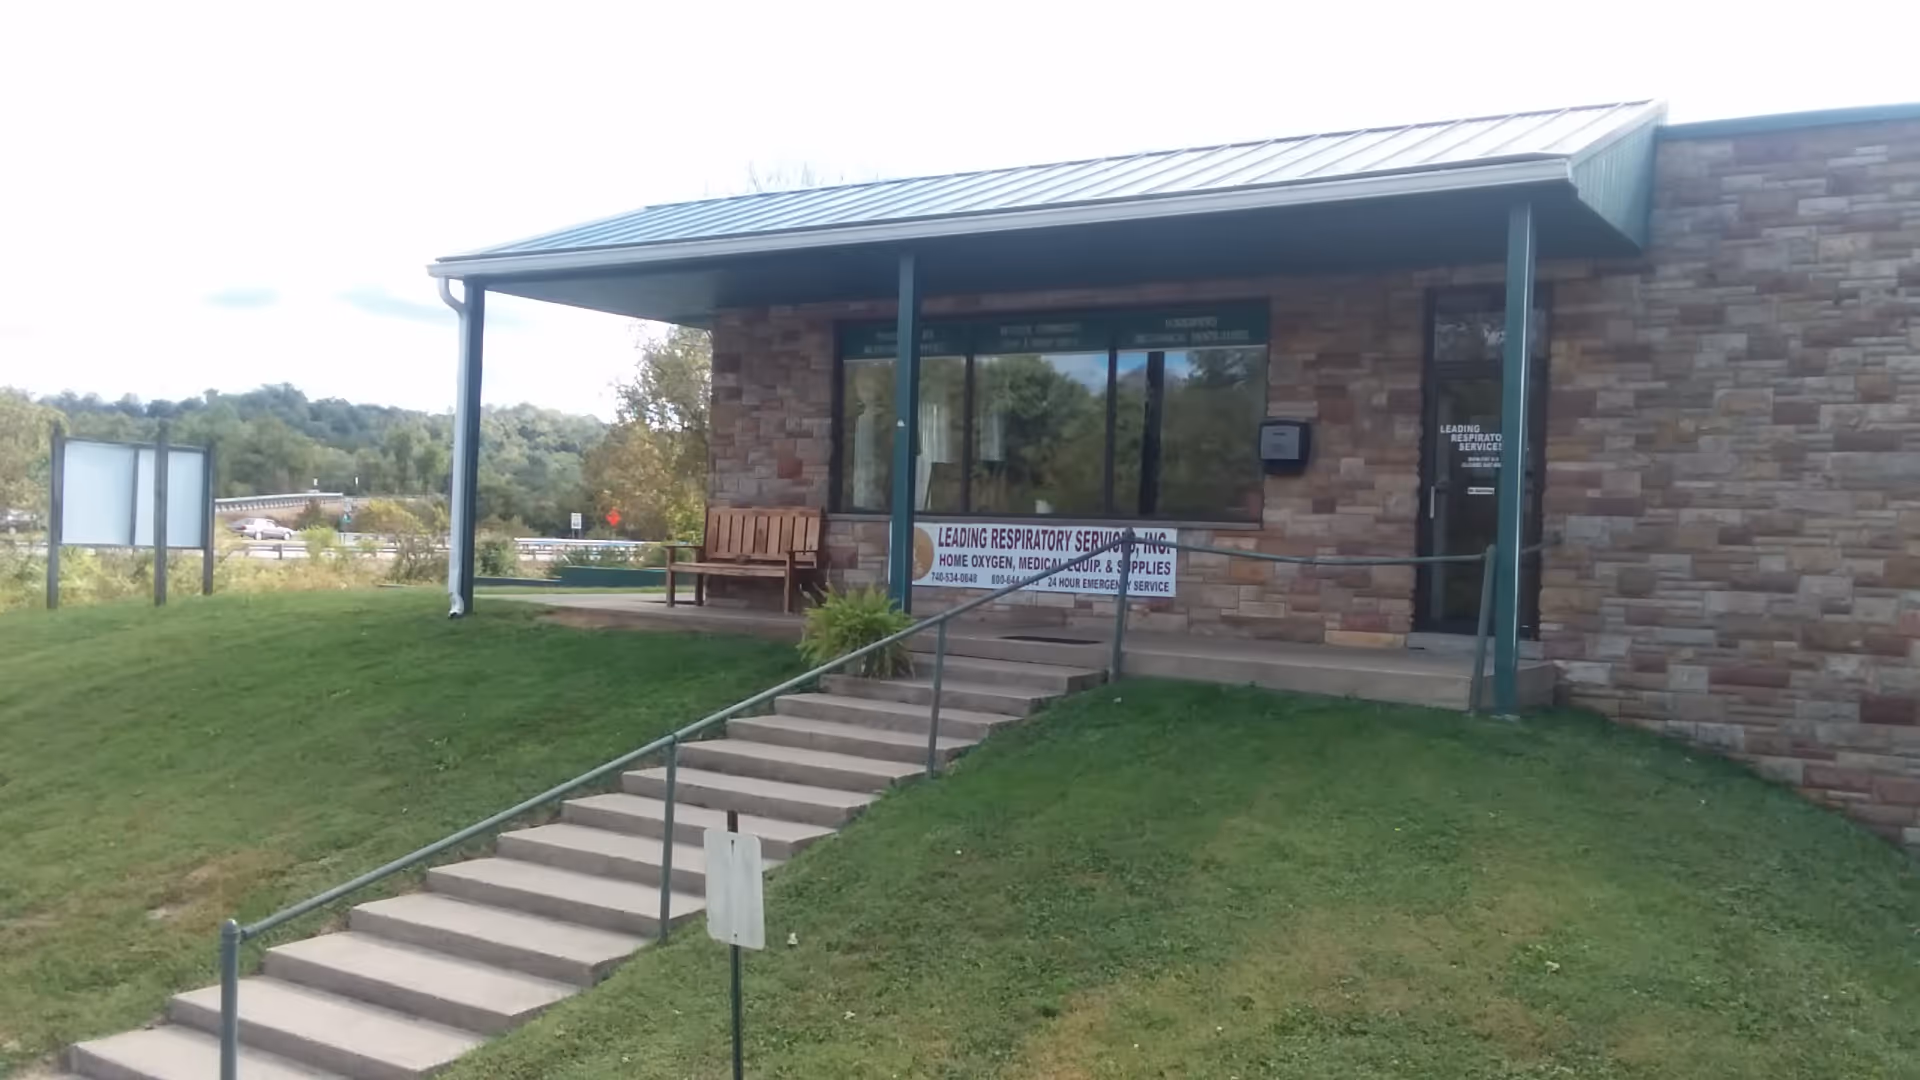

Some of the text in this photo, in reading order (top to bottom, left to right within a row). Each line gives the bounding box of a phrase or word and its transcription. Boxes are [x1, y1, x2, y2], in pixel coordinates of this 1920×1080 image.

[1440, 424, 1480, 433] LEADING
[1450, 433, 1502, 442] RESPIRATO
[938, 527, 987, 548] LEADING
[991, 528, 1072, 552] RESPIRATORY
[1075, 530, 1139, 559] SERVICS,
[939, 554, 968, 567] HOME
[971, 555, 1016, 572] OXYGEN,
[1067, 558, 1101, 573] EQUIP.
[1105, 559, 1113, 573] &
[1117, 560, 1171, 575] SPPLIES
[1048, 577, 1169, 592] 24 HOUR EMERGENY SERVICE
